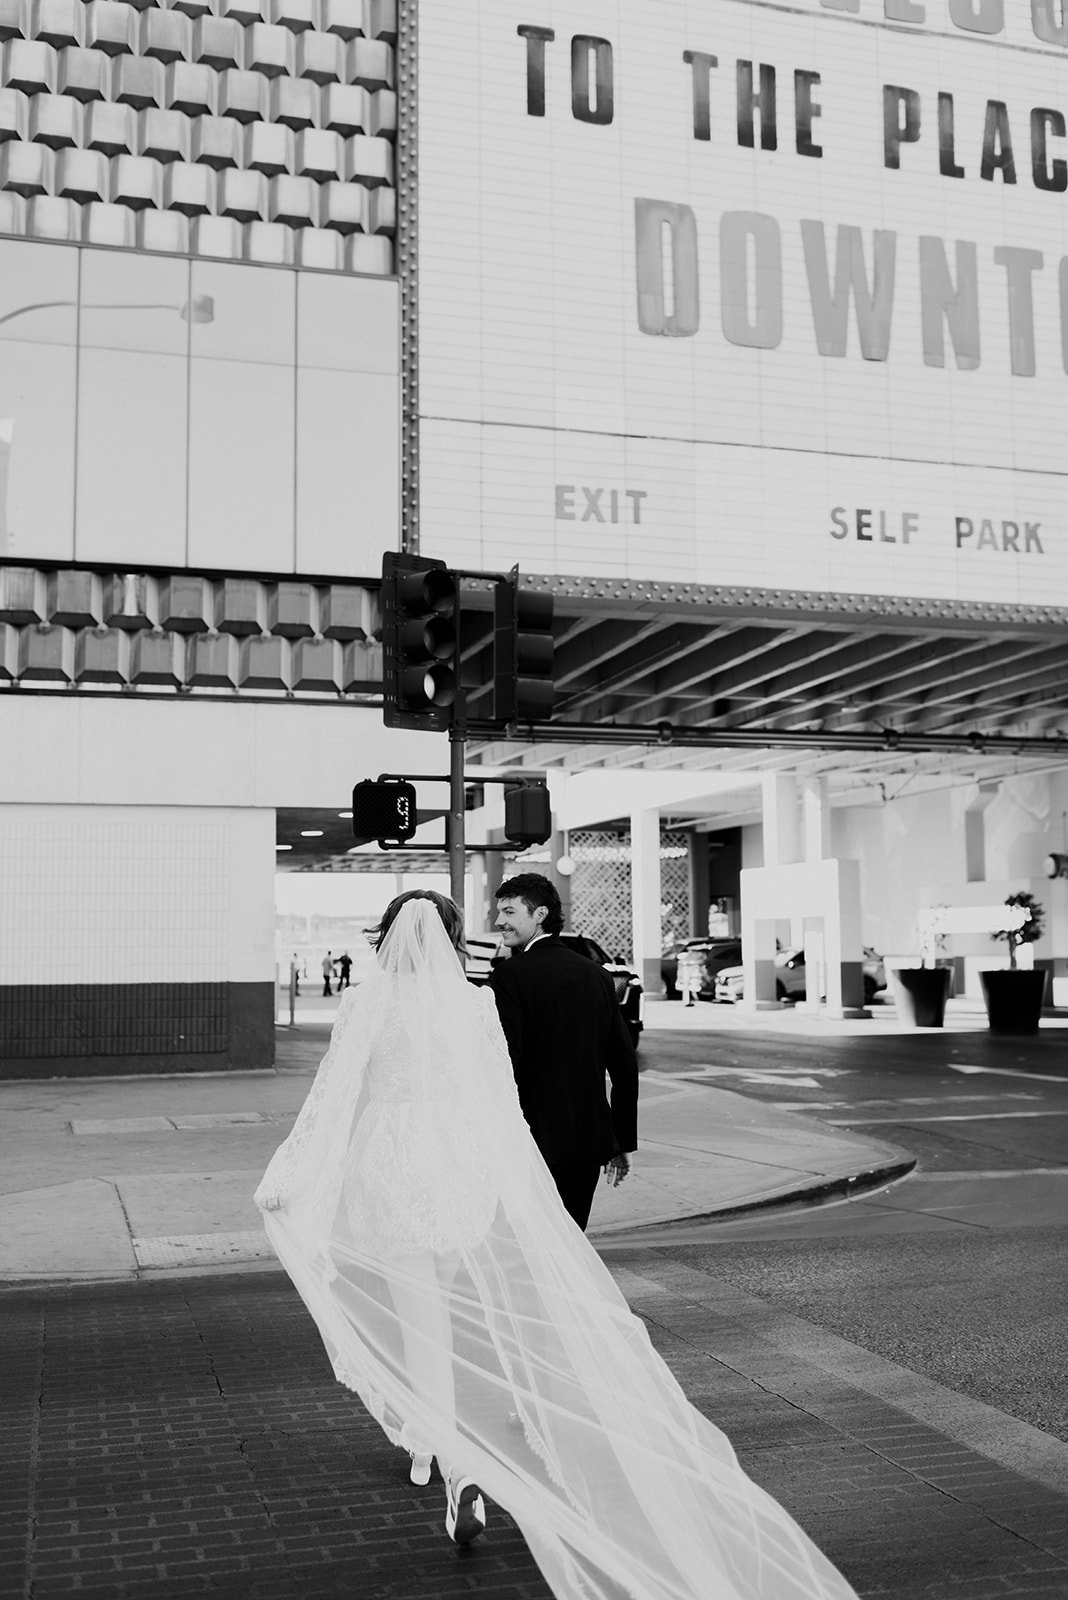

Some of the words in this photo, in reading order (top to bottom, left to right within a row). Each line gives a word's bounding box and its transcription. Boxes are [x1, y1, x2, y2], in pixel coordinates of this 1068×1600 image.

[516, 23, 615, 126] TO
[682, 49, 824, 158] THE
[882, 83, 1068, 193] PLAC
[633, 196, 1068, 378] DOWNT
[554, 484, 648, 525] EXIT
[829, 506, 920, 545] SELF
[954, 516, 1046, 555] PARK
